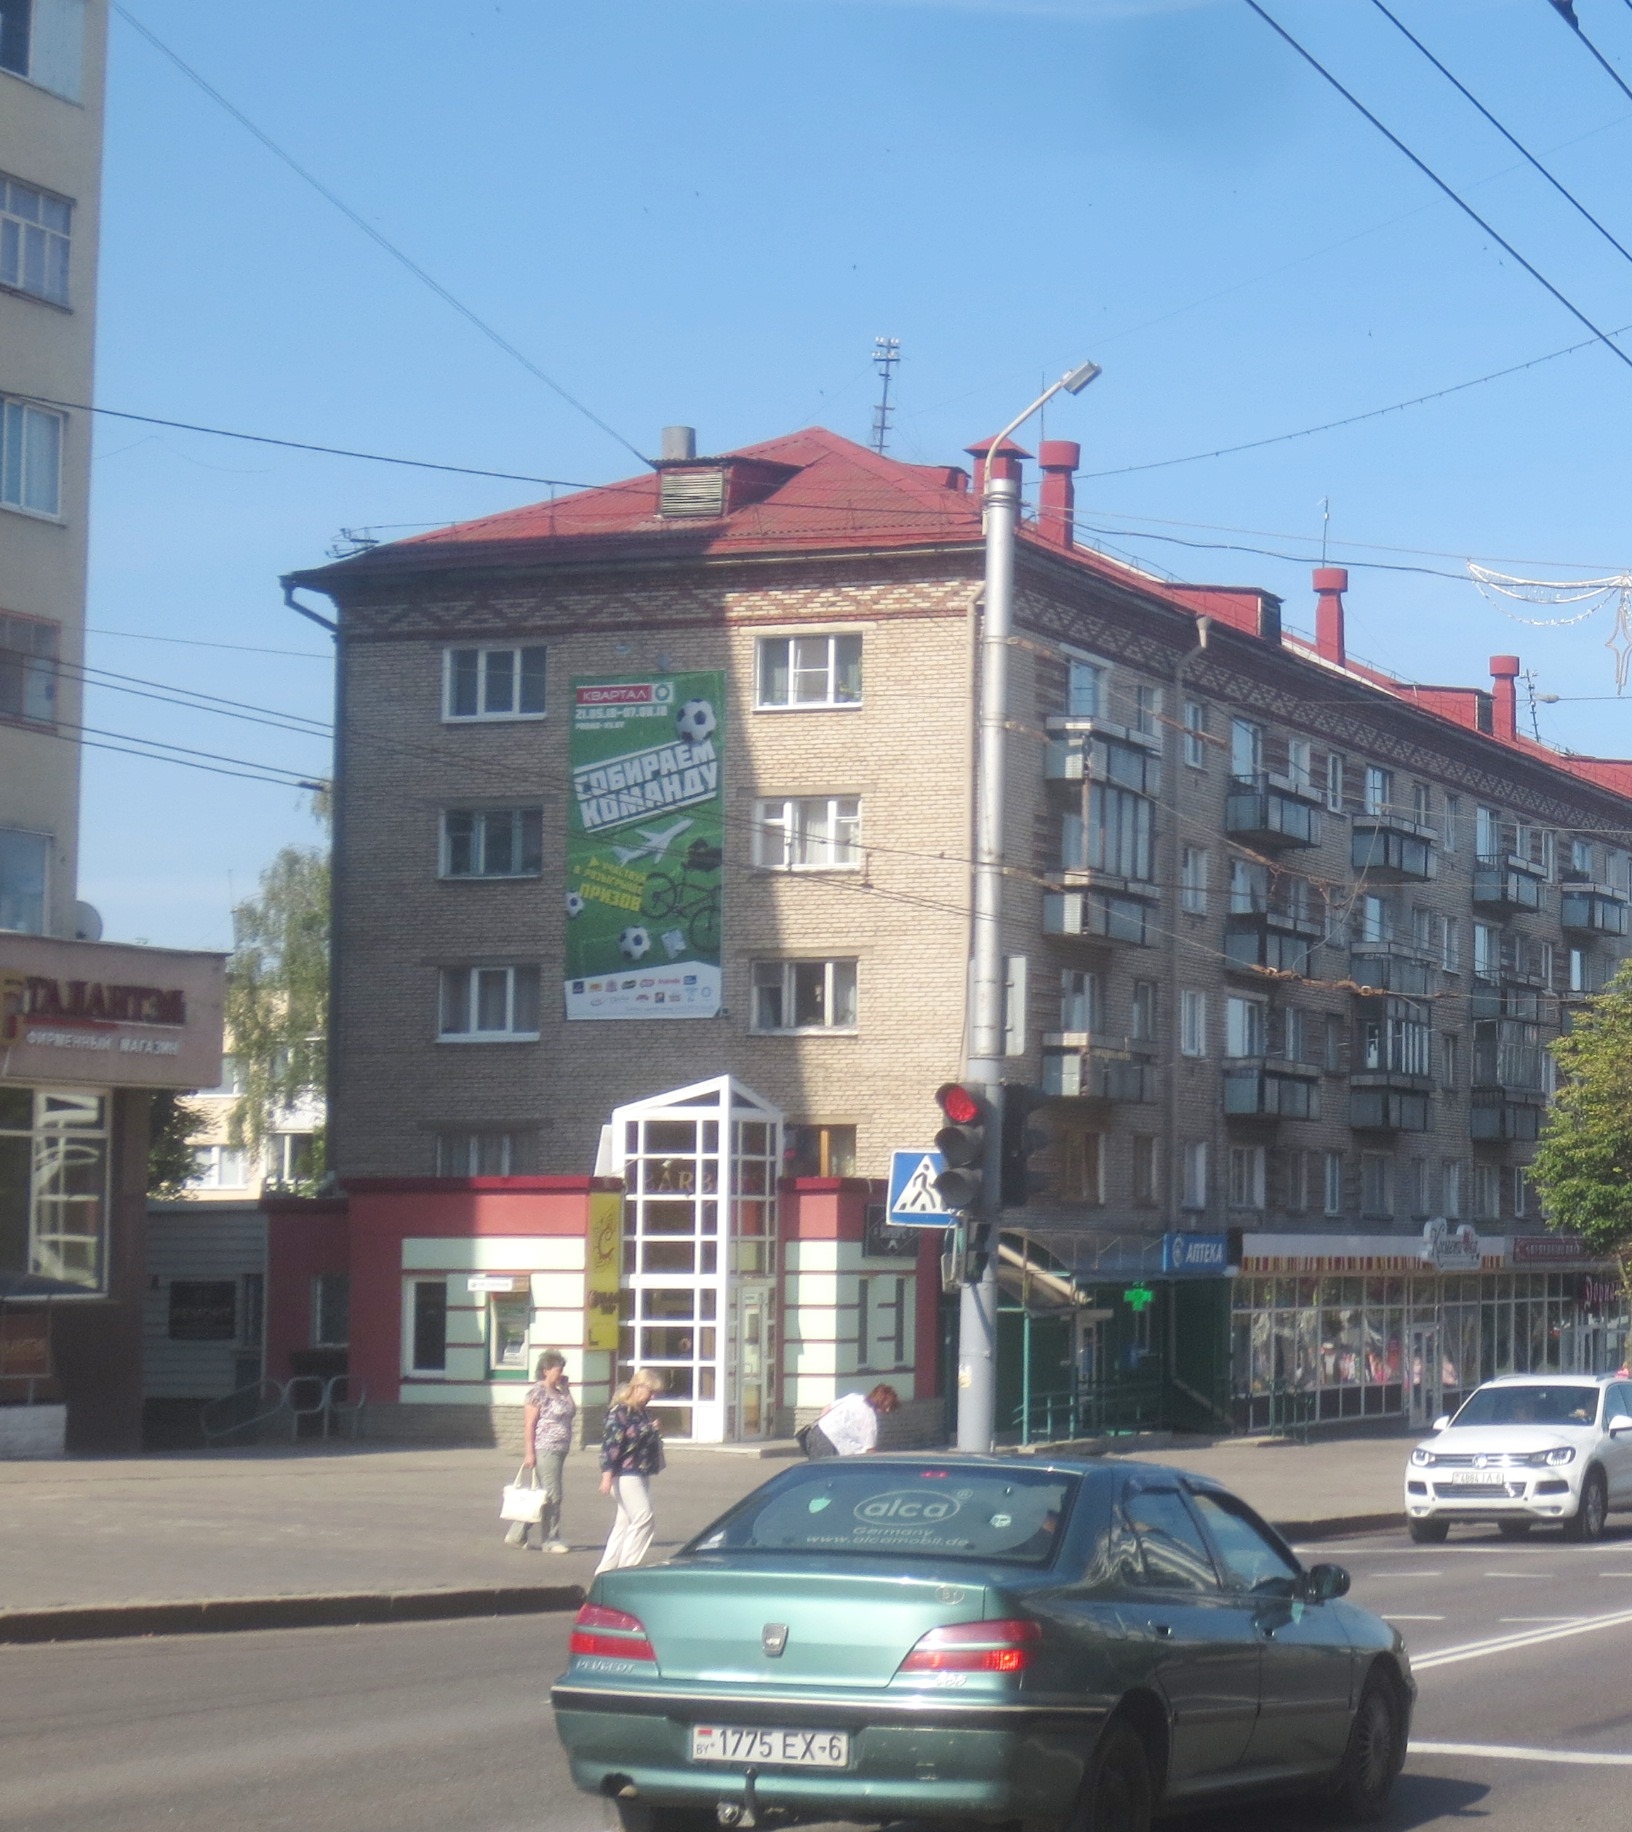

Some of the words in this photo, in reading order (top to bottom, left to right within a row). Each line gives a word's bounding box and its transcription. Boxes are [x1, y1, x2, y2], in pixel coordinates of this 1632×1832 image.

[582, 689, 647, 701] КВАРТАЛ
[574, 740, 716, 801] СОБИРАЕМ
[580, 761, 718, 829] КОМАНДУ
[580, 883, 642, 912] ПРИЗОВ
[26, 1031, 112, 1050] ФИРМЕННЫЙ
[119, 1037, 180, 1055] МАГАЗИН
[1185, 1243, 1223, 1263] АПТЕКА
[863, 1499, 949, 1518] alca
[806, 1536, 969, 1546] www.alcamobil.de
[852, 1527, 934, 1536] Germany
[696, 1743, 709, 1754] BY
[720, 1729, 772, 1758] 1775
[782, 1732, 842, 1761] EX-6
